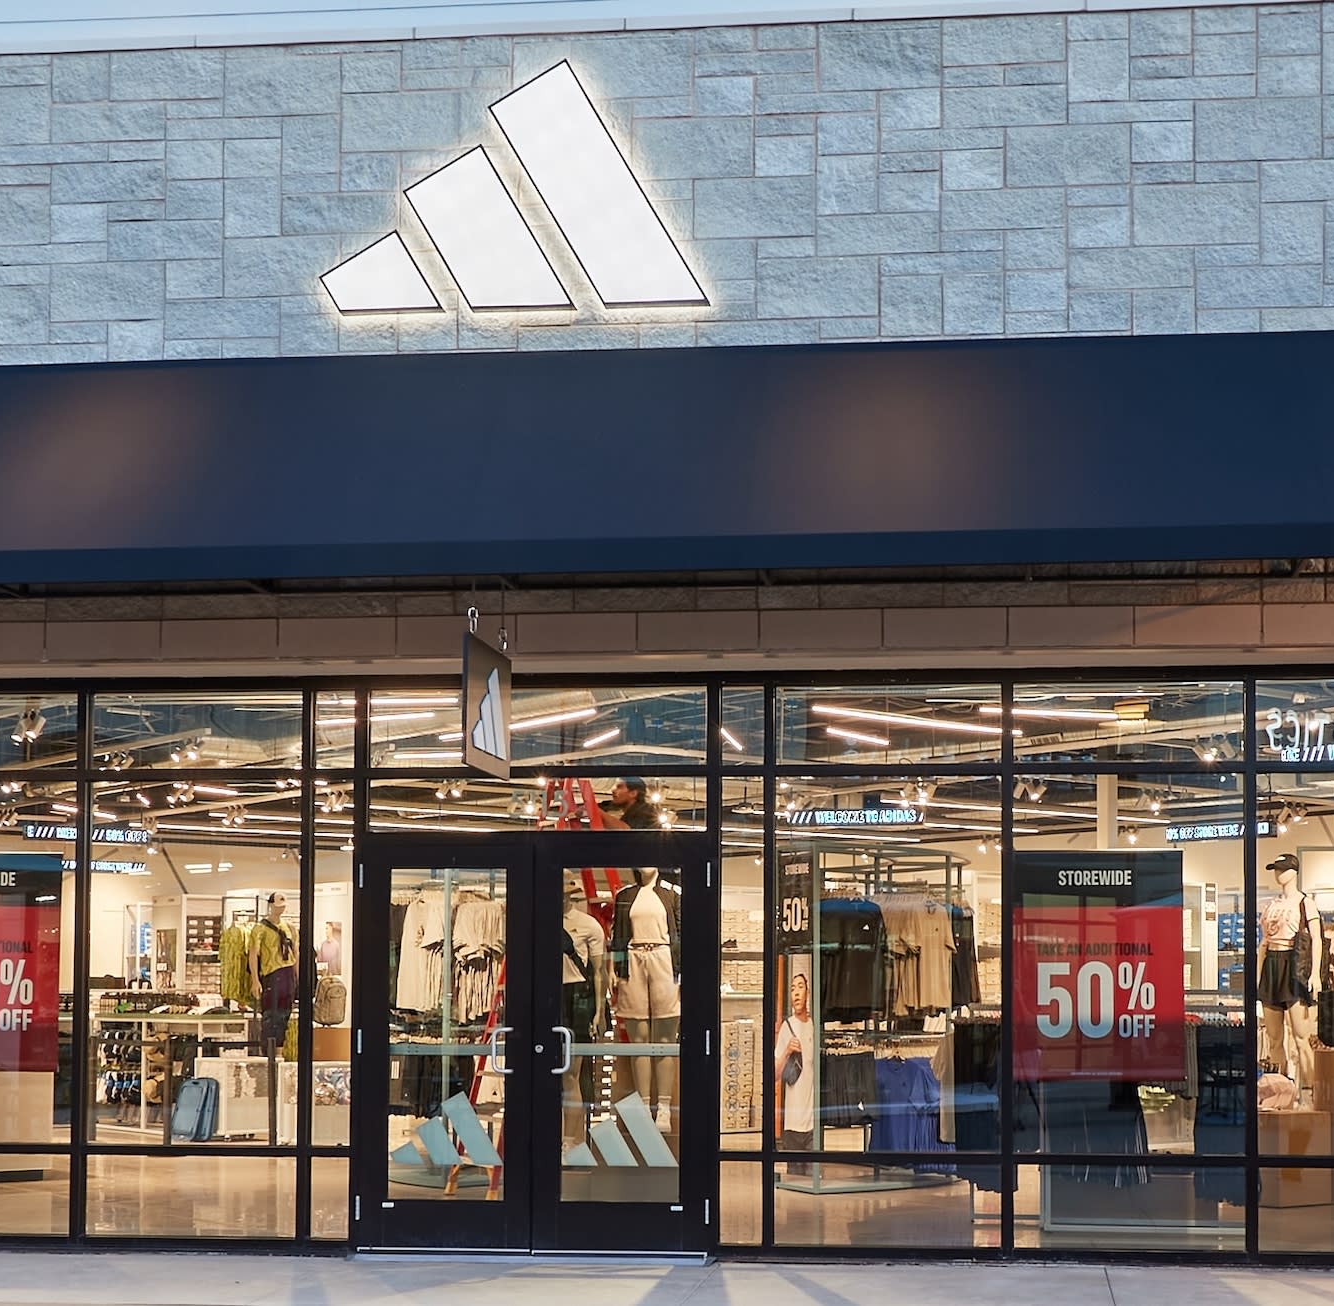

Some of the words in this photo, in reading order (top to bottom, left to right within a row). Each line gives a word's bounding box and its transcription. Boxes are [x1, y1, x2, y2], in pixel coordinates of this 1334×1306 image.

[1058, 870, 1132, 886] STOREWIDE
[1036, 943, 1064, 956] TAKE
[1069, 943, 1082, 955] AN
[1086, 943, 1153, 956] ADDITIONAL
[1036, 960, 1156, 1039] 50%
[1118, 1014, 1156, 1038] OFF
